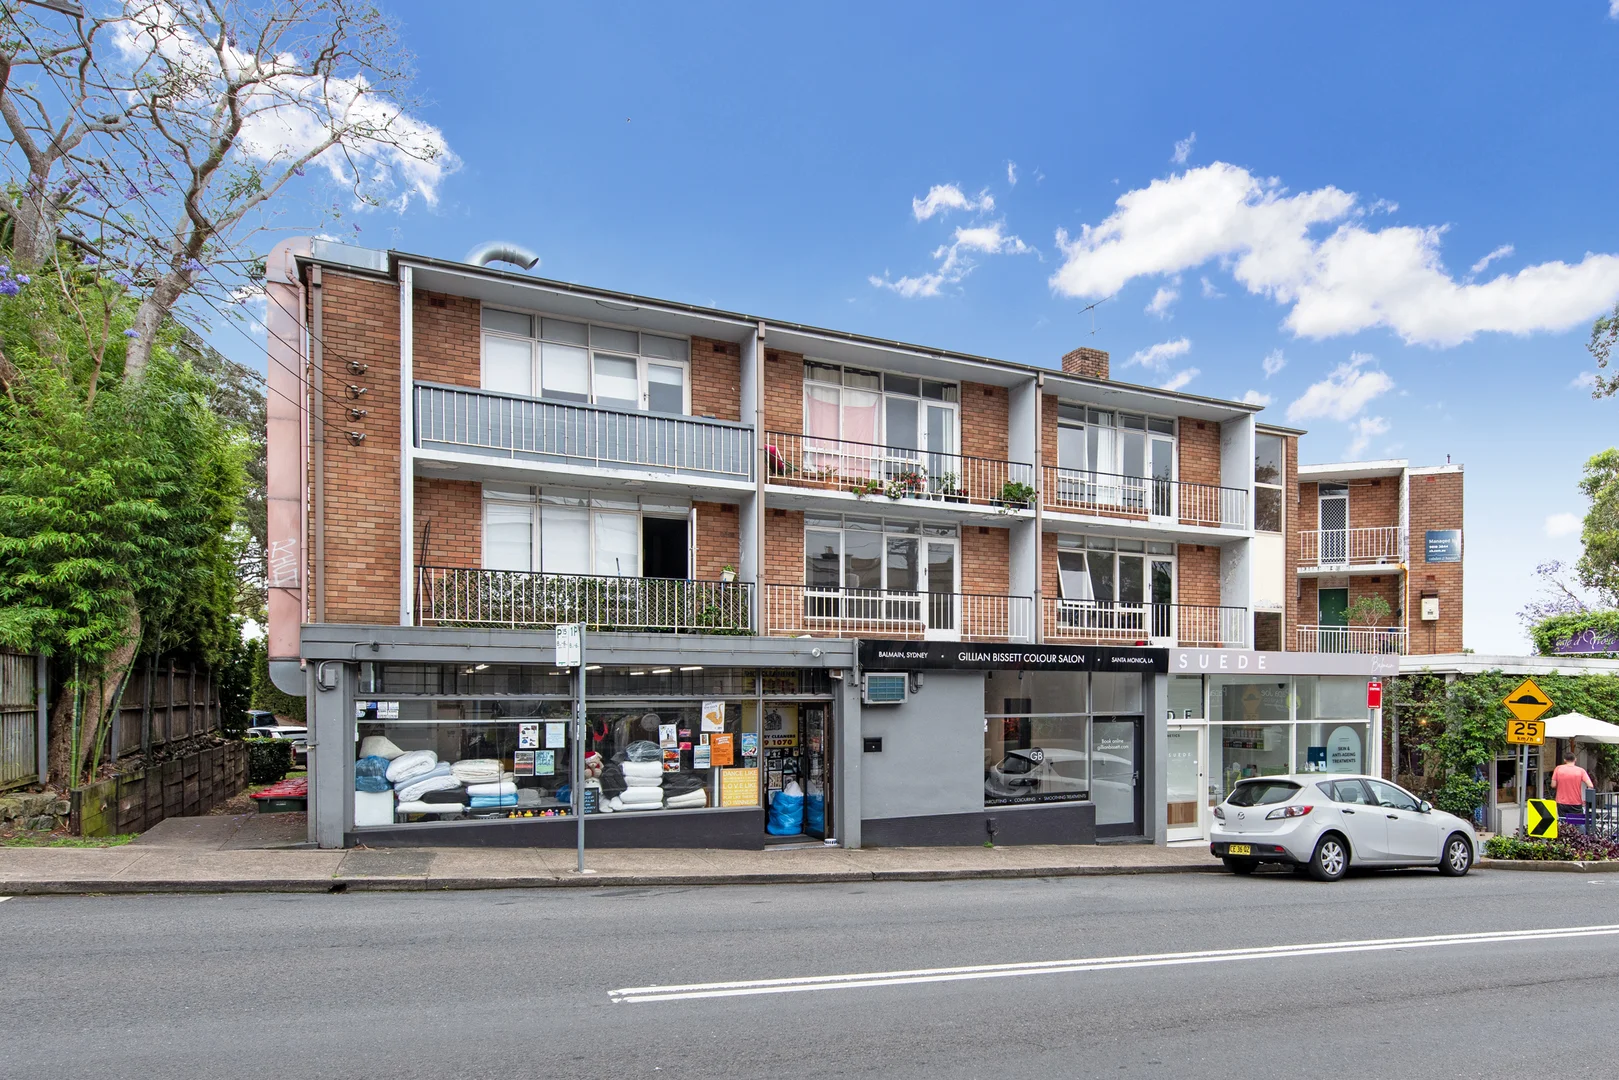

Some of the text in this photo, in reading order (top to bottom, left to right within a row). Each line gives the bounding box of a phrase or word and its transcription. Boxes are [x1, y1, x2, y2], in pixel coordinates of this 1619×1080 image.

[878, 651, 905, 659] BALMAIN,
[958, 652, 1085, 664] GILLIAN BISSETT COLOUR SALON
[1179, 654, 1266, 669] SUEDE
[1514, 722, 1538, 736] 25
[1030, 752, 1043, 761] GB
